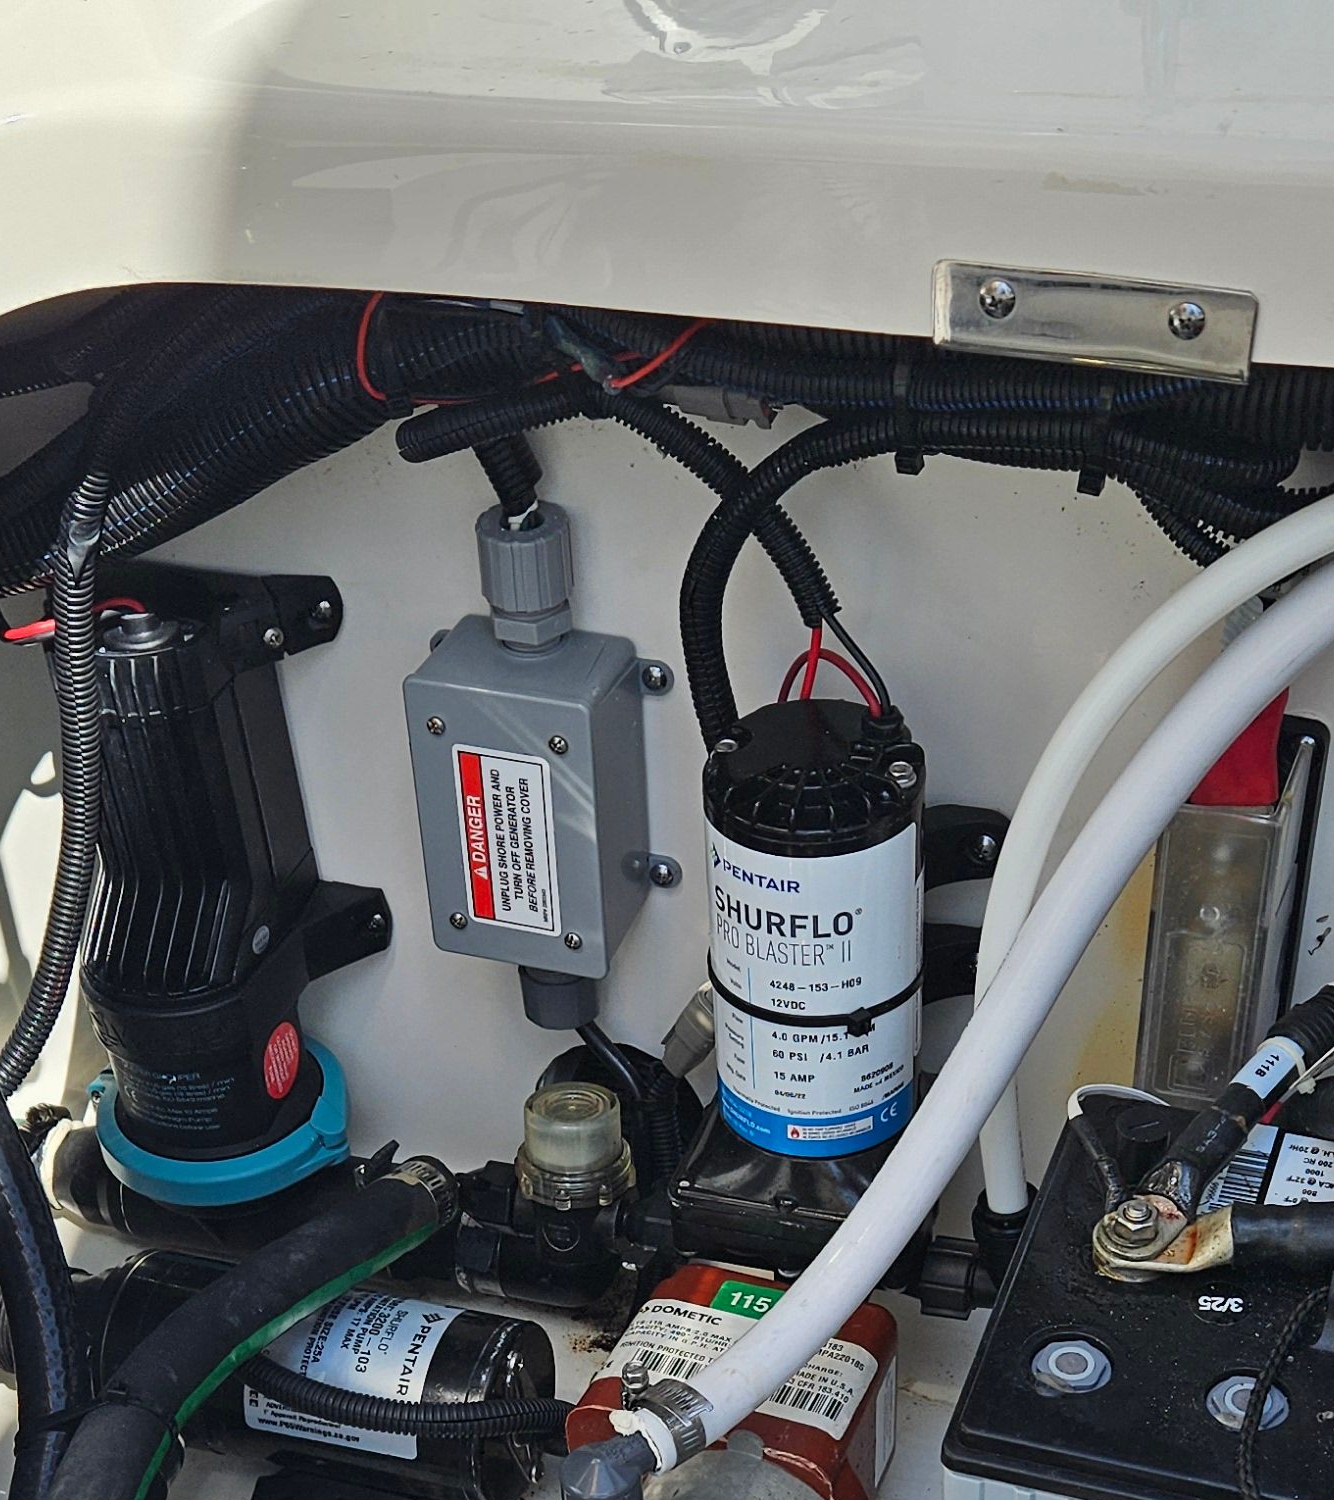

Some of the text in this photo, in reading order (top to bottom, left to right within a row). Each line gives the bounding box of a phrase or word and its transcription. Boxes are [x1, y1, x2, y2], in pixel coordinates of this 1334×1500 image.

[466, 795, 486, 862] DANGER
[490, 768, 511, 910] UNPLUG SHORE POWER AND
[505, 785, 523, 899] TURN OFF GENERATOR
[518, 777, 537, 911] BEFORE REMOVING COVER
[722, 860, 800, 894] PENTAIR
[716, 914, 740, 949] PRO
[841, 940, 851, 962] II
[770, 998, 806, 1011] 12VDC
[772, 1031, 818, 1043] 4.0 GPM
[773, 1044, 869, 1062] 60 PSI BAR
[774, 1071, 815, 1083] 15 AMP
[1302, 1156, 1333, 1168] 200 RC
[1304, 1167, 1325, 1177] 1000
[728, 1290, 772, 1314] 115
[1198, 1293, 1245, 1314] 3/25
[650, 1302, 722, 1327] DOMETIC
[338, 1328, 356, 1349] MAX
[347, 1326, 370, 1354] PUMP
[394, 1324, 432, 1396] PENTAIR
